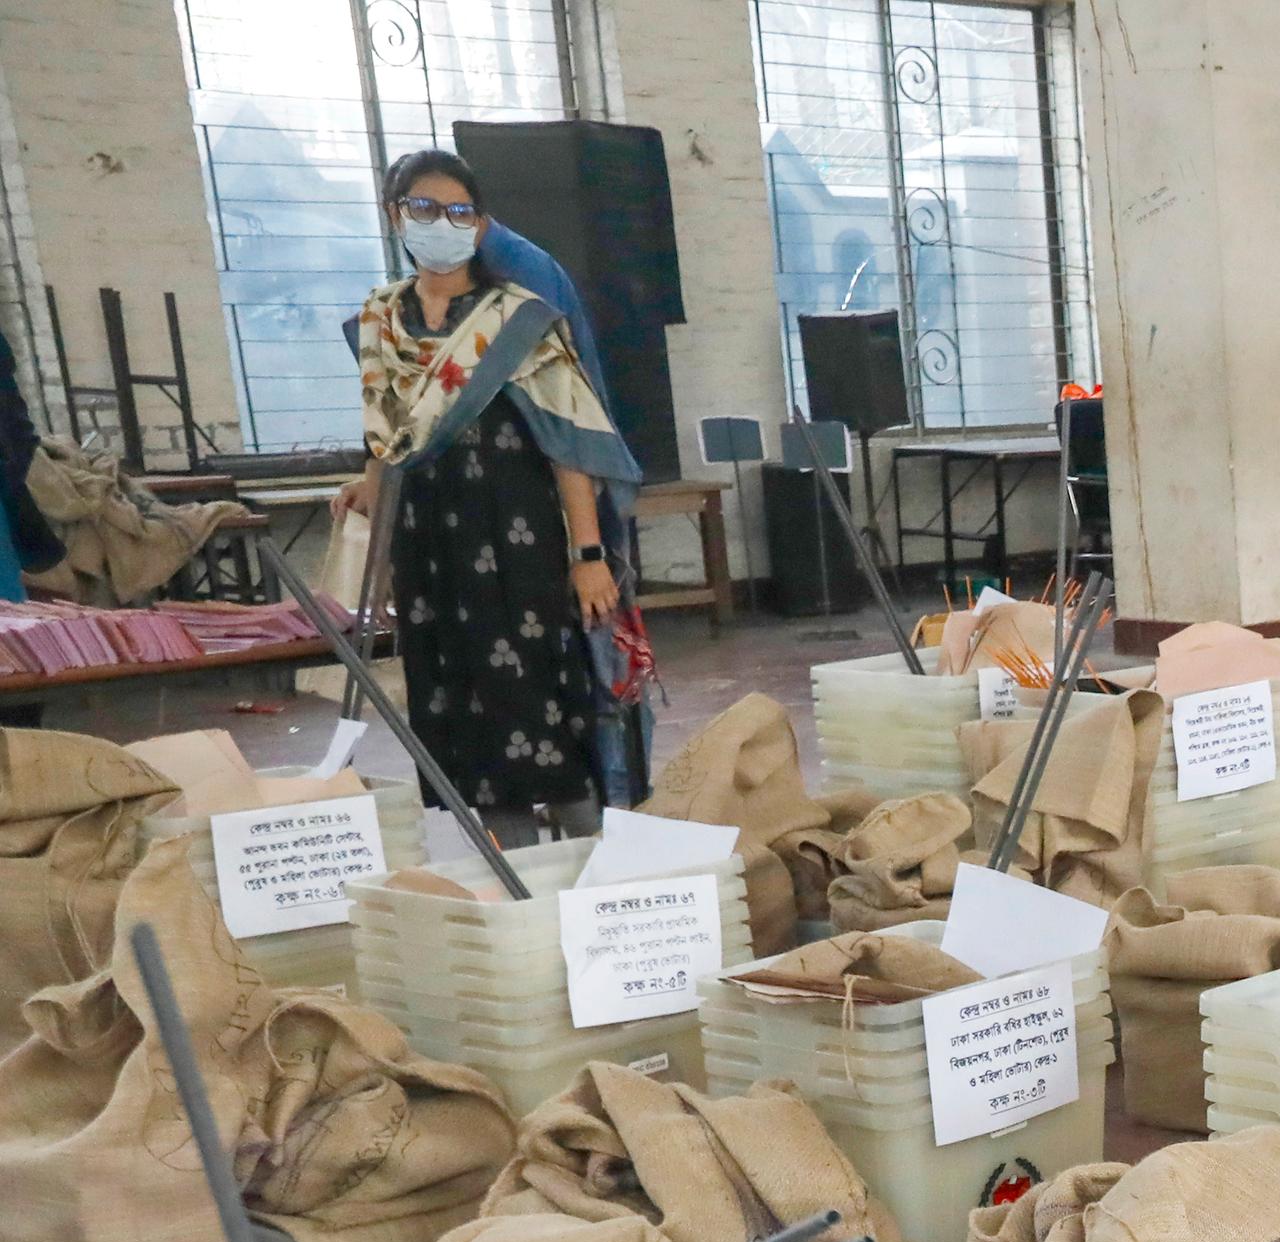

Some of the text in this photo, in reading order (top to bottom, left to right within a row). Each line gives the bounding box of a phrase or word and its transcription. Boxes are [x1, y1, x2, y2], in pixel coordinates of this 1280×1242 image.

[959, 1005, 980, 1019] কেন্দ্র
[982, 999, 1001, 1012] নম্বর
[951, 1033, 970, 1047] ঢাকা
[994, 1044, 1011, 1056] ঢাকা
[979, 1067, 1002, 1085] মহিলা
[989, 1094, 1009, 1110] কক্ষ
